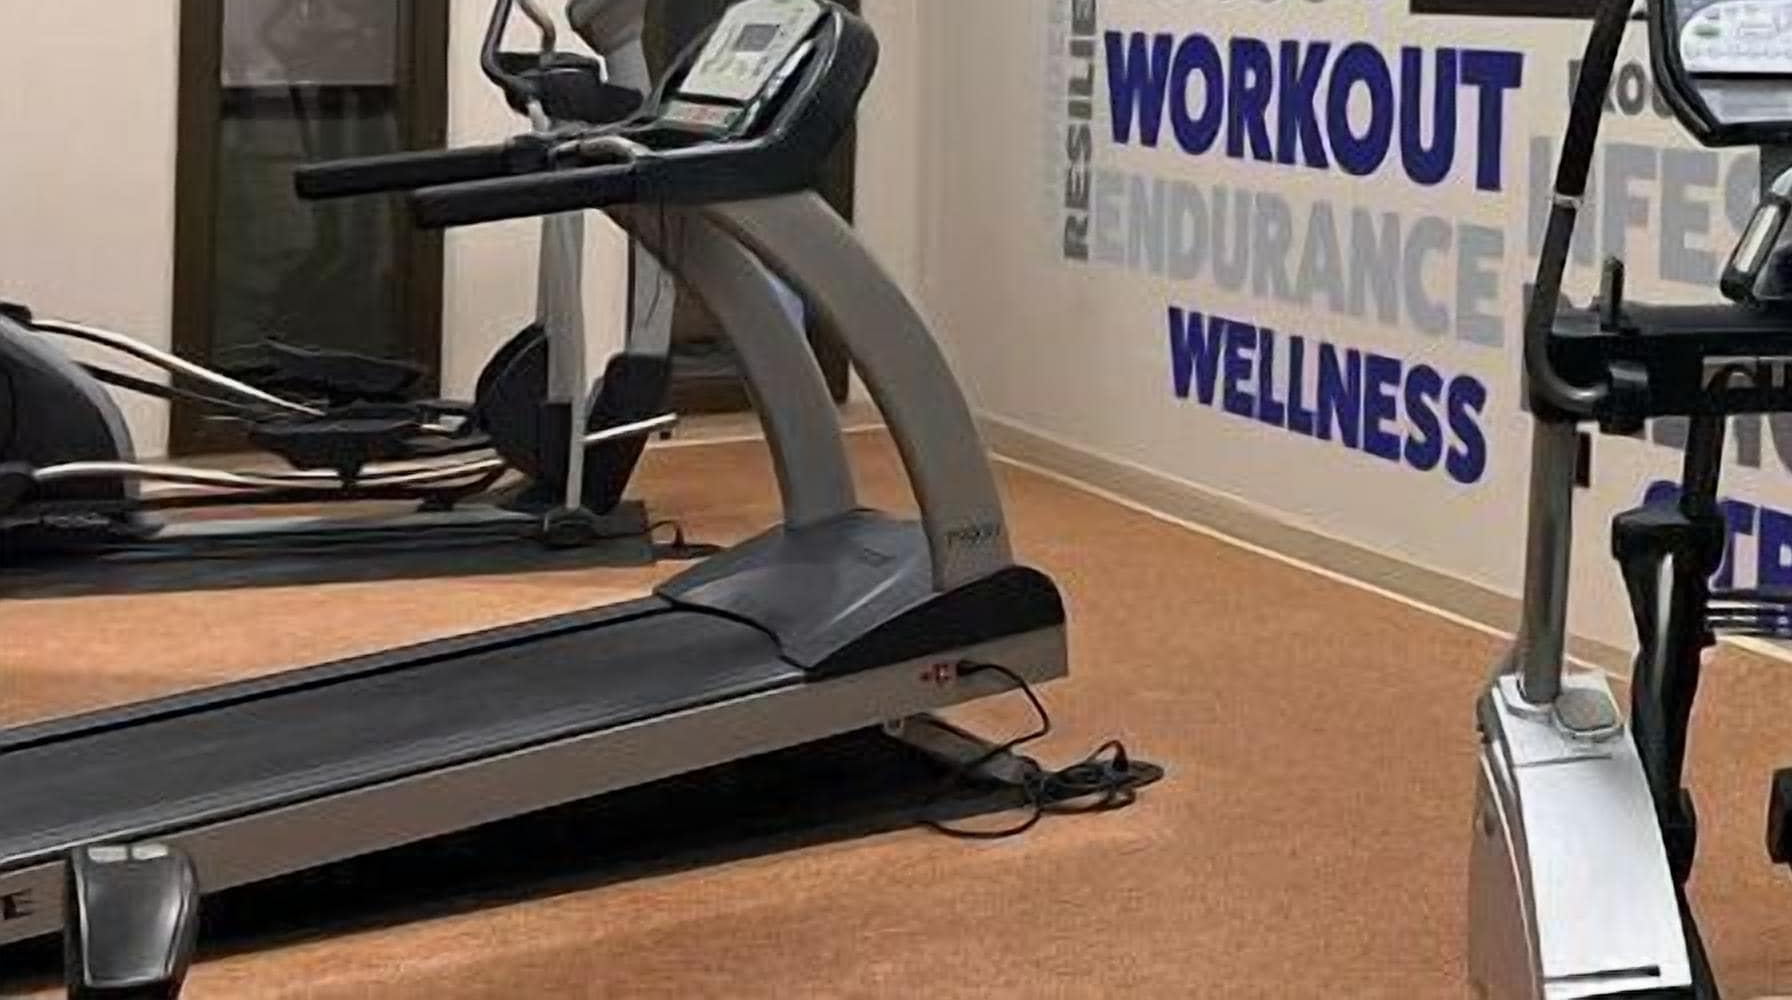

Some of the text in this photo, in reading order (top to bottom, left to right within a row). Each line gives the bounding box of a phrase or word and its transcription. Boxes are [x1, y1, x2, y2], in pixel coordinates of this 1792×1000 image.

[1103, 30, 1525, 192] WORKOUT
[1094, 168, 1505, 348] ENDURANCE
[1167, 305, 1488, 485] WELLNESS
